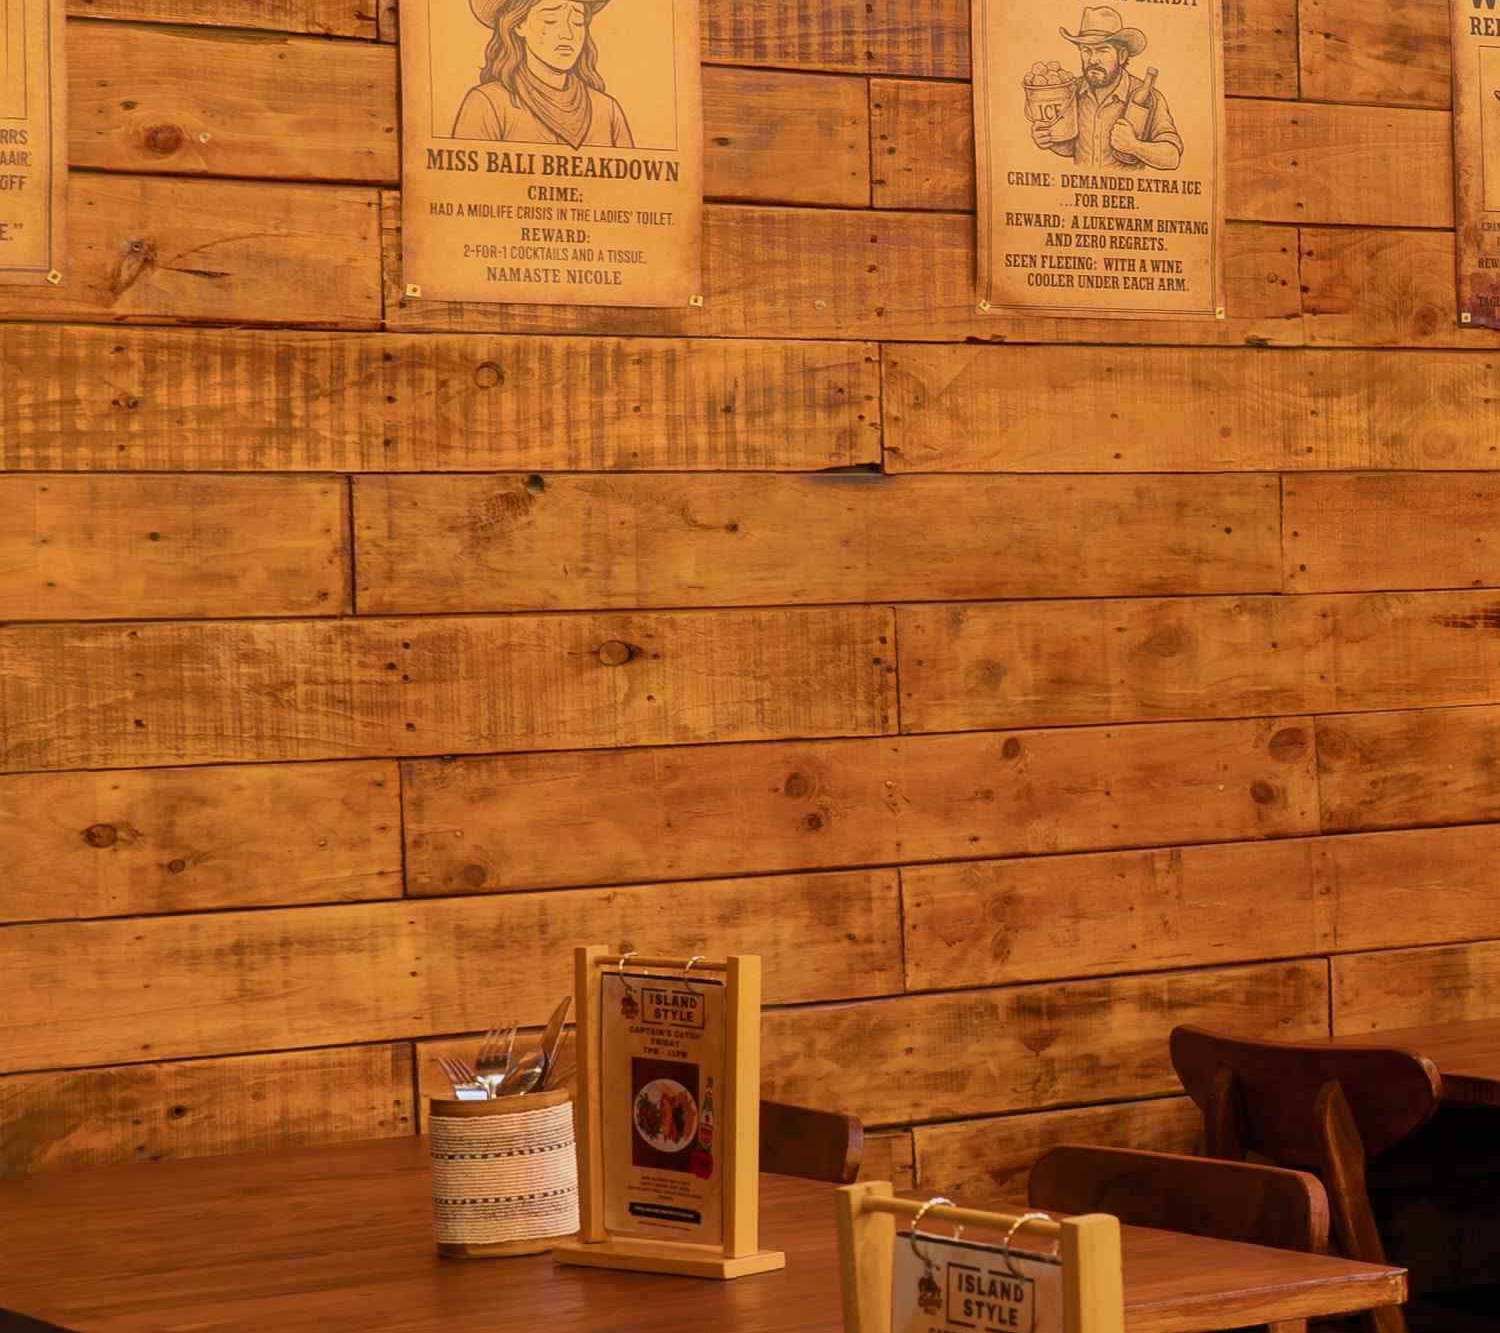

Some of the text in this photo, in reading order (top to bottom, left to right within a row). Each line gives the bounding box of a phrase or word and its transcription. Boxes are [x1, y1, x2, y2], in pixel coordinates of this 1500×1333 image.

[427, 149, 680, 182] MISS BALI BREAKDOWN
[1008, 172, 1202, 195] CRIME: DEMANDED EXTRA ICE
[528, 186, 583, 203] CRIME:
[1103, 195, 1140, 210] BEER.
[430, 202, 453, 216] HAD
[457, 204, 465, 216] A
[468, 204, 513, 219] MIDLIFE
[517, 206, 552, 220] CRISIS
[556, 208, 567, 220] IN
[570, 208, 591, 222] THE
[521, 228, 590, 244] REWARD:
[487, 267, 622, 286] NAMASTE NICOLE
[649, 993, 698, 1008] ISLAND
[654, 1008, 693, 1022] STYLE
[958, 1273, 1024, 1303] ISLAND
[963, 1298, 1019, 1326] STYLE
